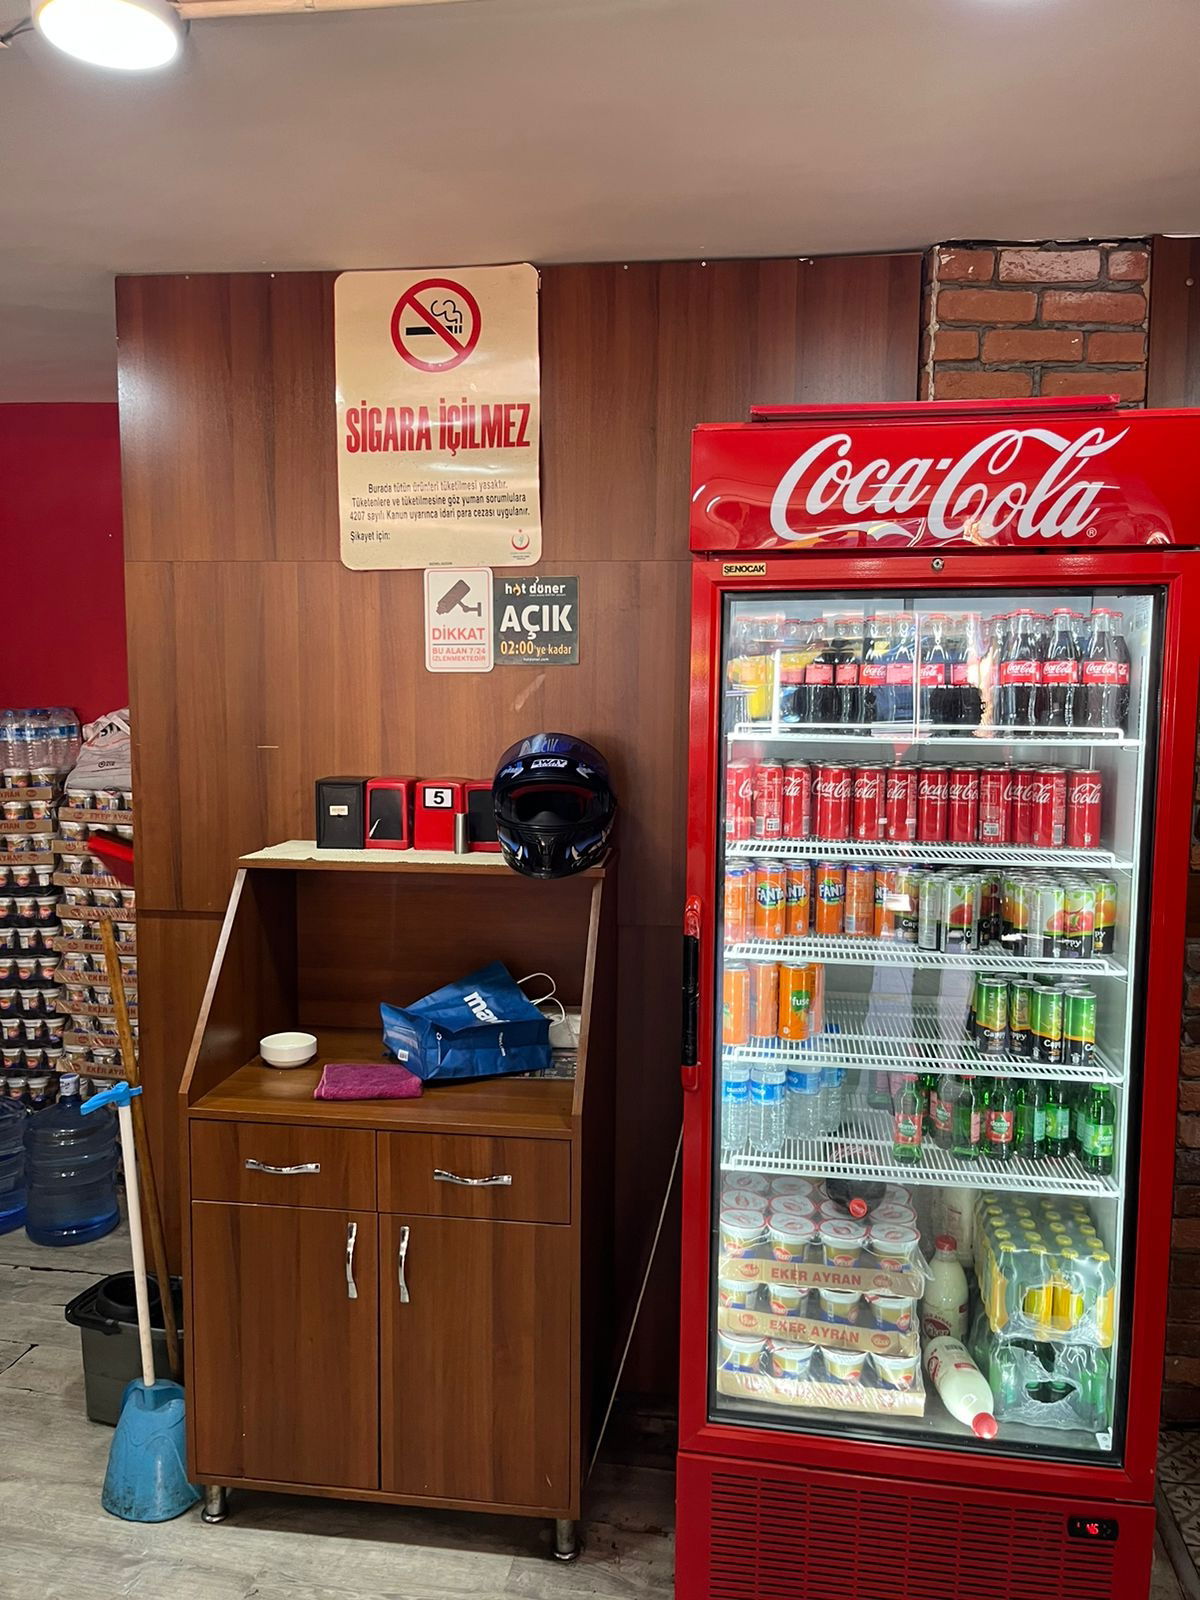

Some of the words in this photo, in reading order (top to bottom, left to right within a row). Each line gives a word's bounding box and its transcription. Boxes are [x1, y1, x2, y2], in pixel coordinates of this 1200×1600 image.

[346, 400, 432, 453] SİGARA
[439, 397, 531, 456] İÇİLMEZ
[368, 483, 392, 493] Burada
[393, 482, 411, 492] tütün
[413, 481, 439, 492] ürünleri
[440, 480, 478, 491] tüketilmesi
[479, 480, 508, 492] yasaktır.
[769, 426, 1131, 542] Coca-Cola
[352, 497, 391, 507] Tüketenlere
[392, 498, 400, 506] ve
[401, 495, 446, 506] tüketilmesine
[447, 494, 460, 507] göz
[461, 495, 484, 506] yuman
[485, 492, 526, 503] sorumlulara
[350, 510, 365, 521] 4207
[367, 510, 385, 522] sayılı
[386, 510, 408, 520] Kanun
[409, 510, 438, 521] uyarınca
[439, 507, 455, 518] idari
[456, 509, 472, 520] para
[473, 509, 495, 517] cezası
[496, 506, 530, 519] uygulanır.
[350, 530, 375, 543] Şikayet
[376, 530, 390, 543] için:
[724, 565, 765, 573] ŞENOCAK
[500, 604, 573, 640] AÇIK
[432, 625, 485, 640] DİKKAT
[548, 644, 572, 655] kadar
[433, 790, 445, 806] 5
[463, 991, 511, 1024] mav
[770, 1267, 808, 1282] EKER
[812, 1272, 862, 1287] AYRAN
[768, 1319, 807, 1335] EKER
[811, 1325, 860, 1344] AYRAN
